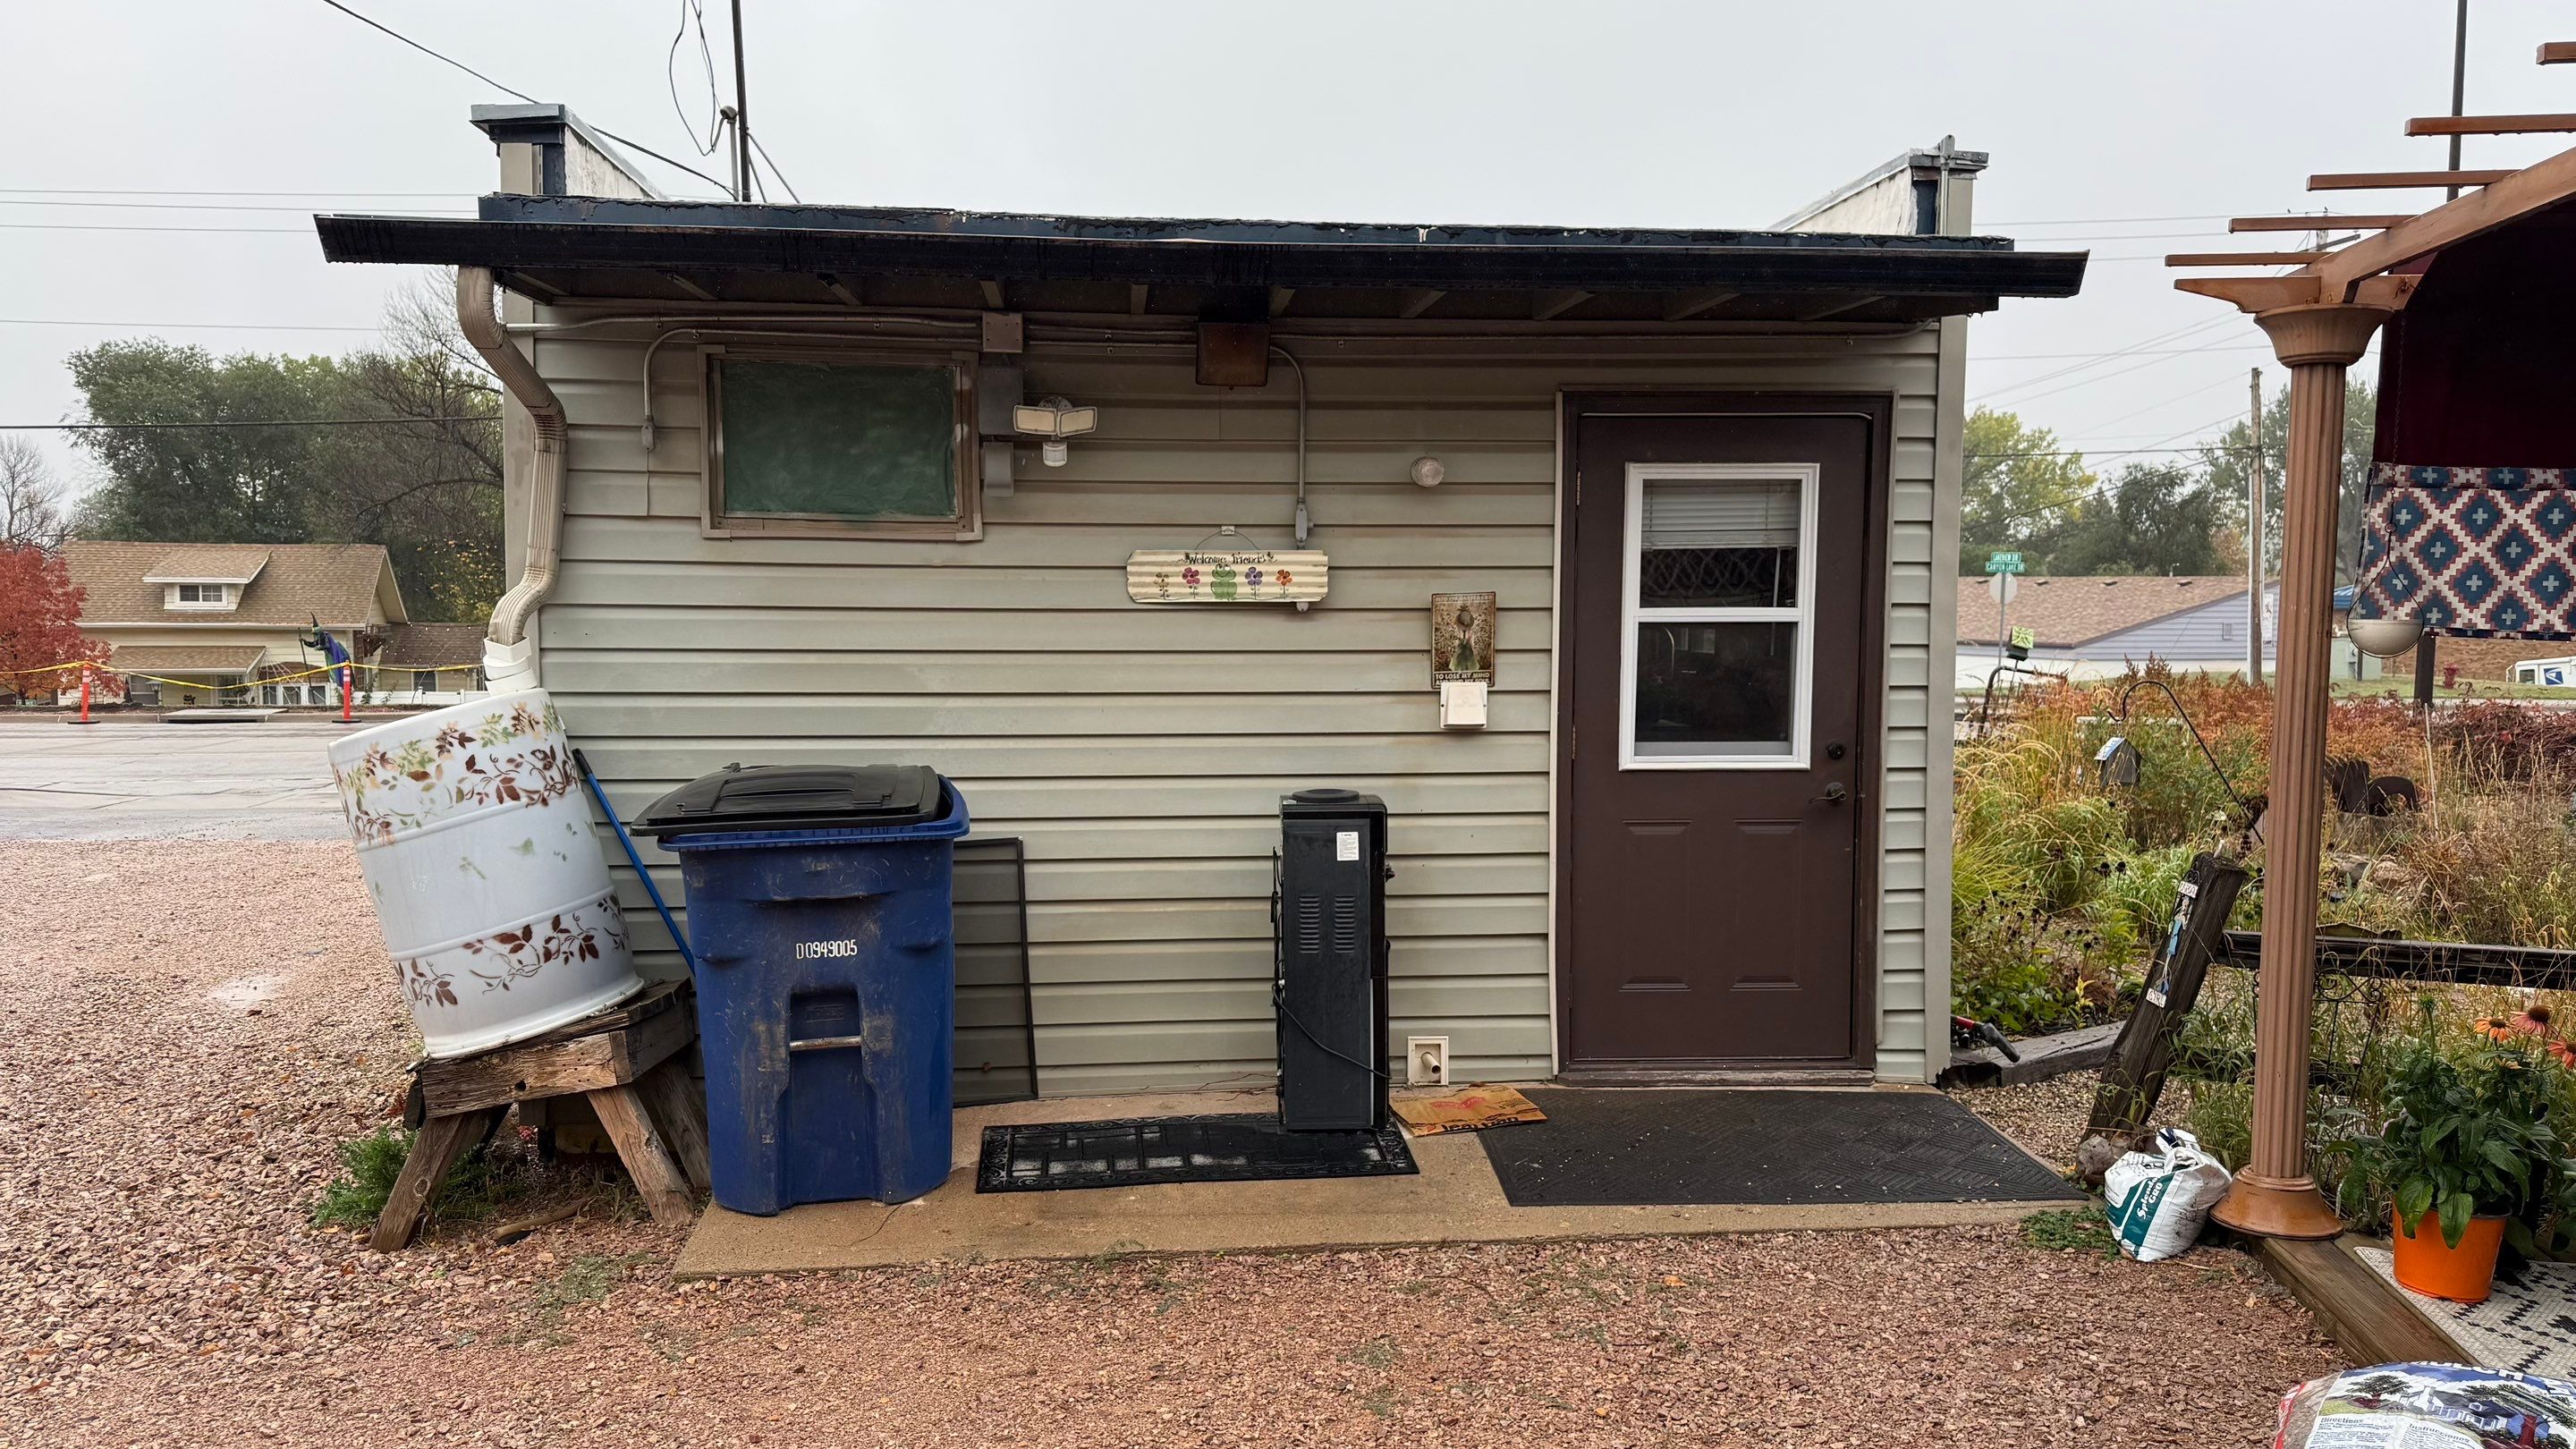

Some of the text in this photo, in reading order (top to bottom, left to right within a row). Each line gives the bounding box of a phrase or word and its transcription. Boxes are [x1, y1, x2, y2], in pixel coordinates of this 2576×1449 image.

[1185, 552, 1227, 564] Welcome
[1987, 563, 2005, 571] CANYON
[2148, 1182, 2163, 1204] GRO
